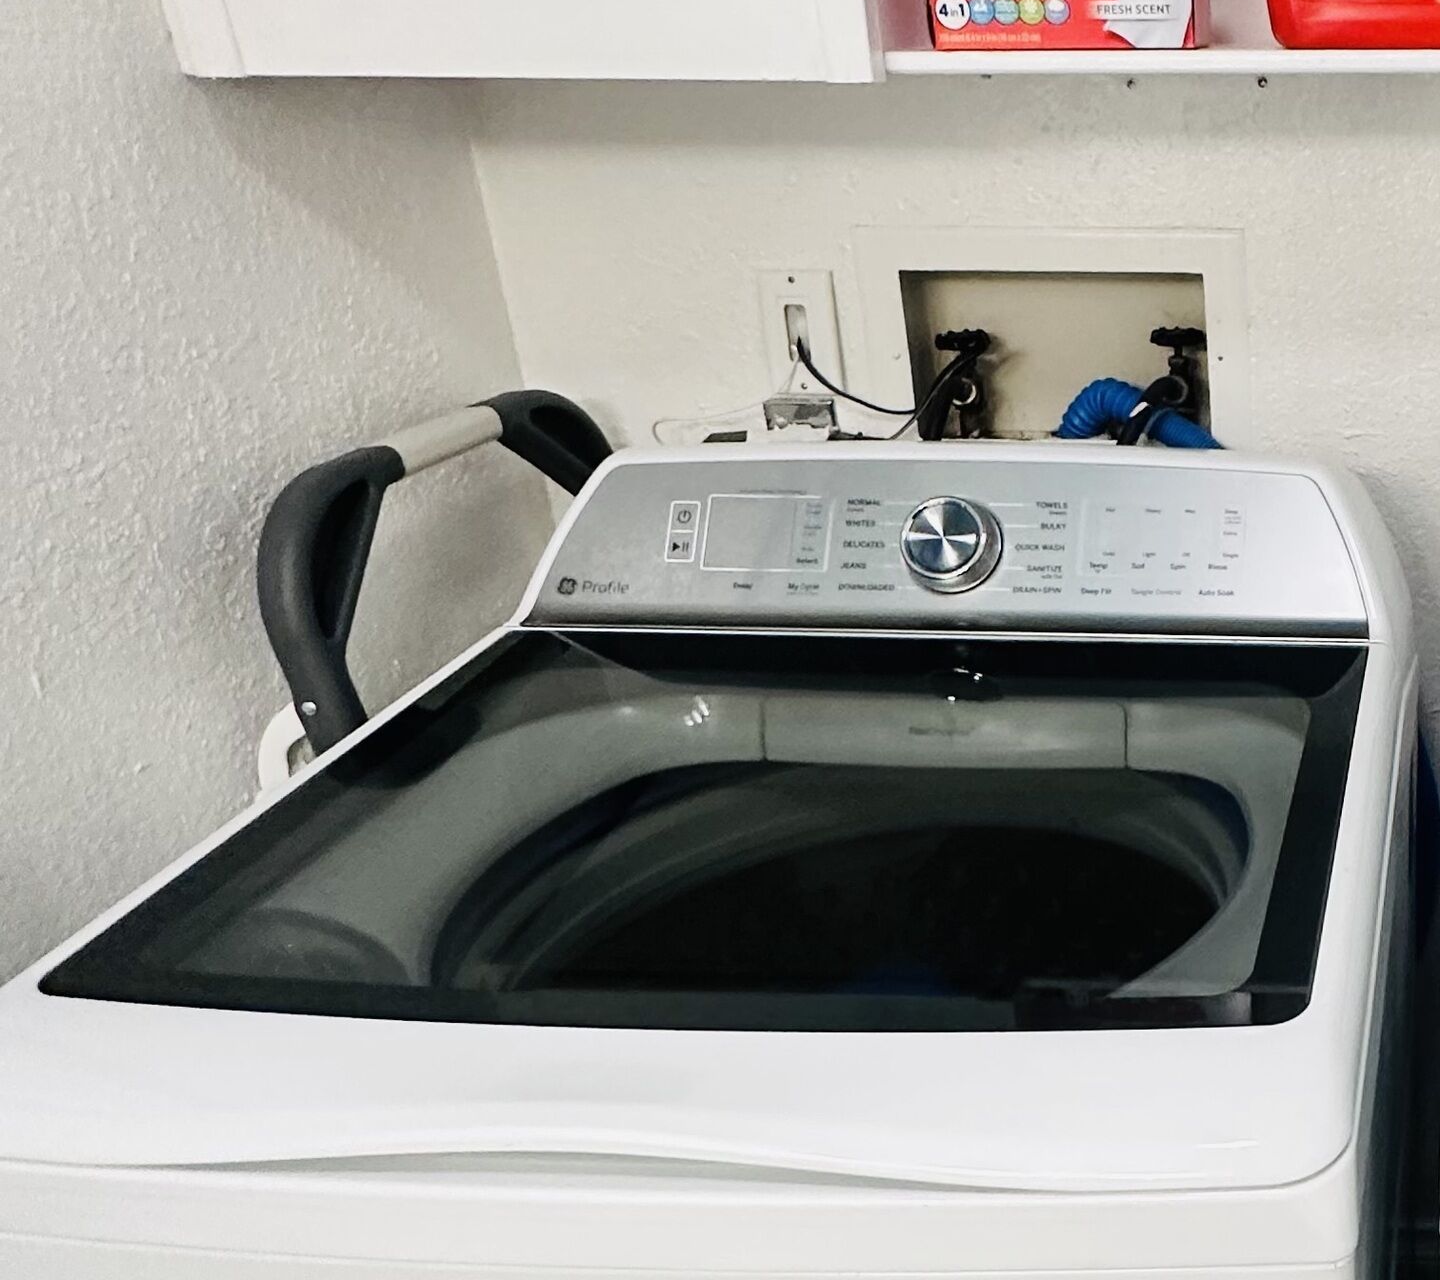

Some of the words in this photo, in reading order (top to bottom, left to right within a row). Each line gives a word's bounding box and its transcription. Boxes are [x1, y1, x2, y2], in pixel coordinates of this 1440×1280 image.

[939, 4, 949, 17] 4
[958, 3, 966, 17] 1
[1097, 4, 1132, 15] FRESH
[1135, 4, 1171, 15] SCENT
[1036, 502, 1068, 510] TOWELS
[1040, 522, 1066, 530] BULKY
[843, 541, 885, 549] DELICATES
[582, 581, 629, 595] Profile
